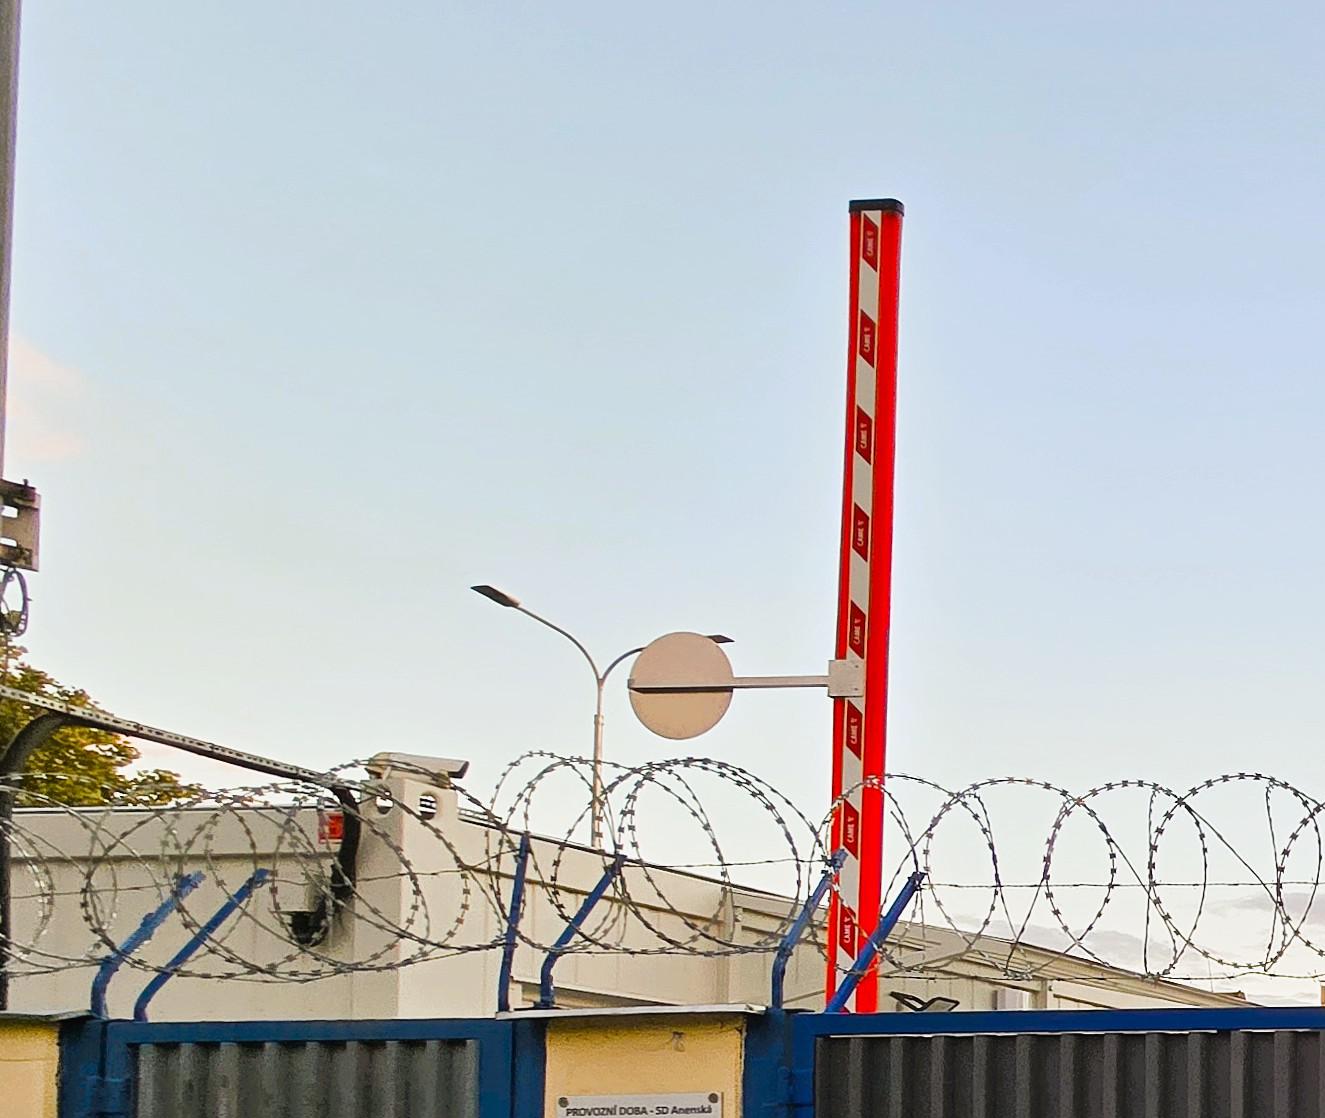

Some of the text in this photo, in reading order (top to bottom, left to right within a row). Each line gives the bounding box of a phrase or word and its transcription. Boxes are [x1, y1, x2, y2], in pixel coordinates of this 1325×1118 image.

[566, 1105, 617, 1116] PROVOZNÍ
[619, 1107, 648, 1116] DOBA
[655, 1106, 669, 1115] SD
